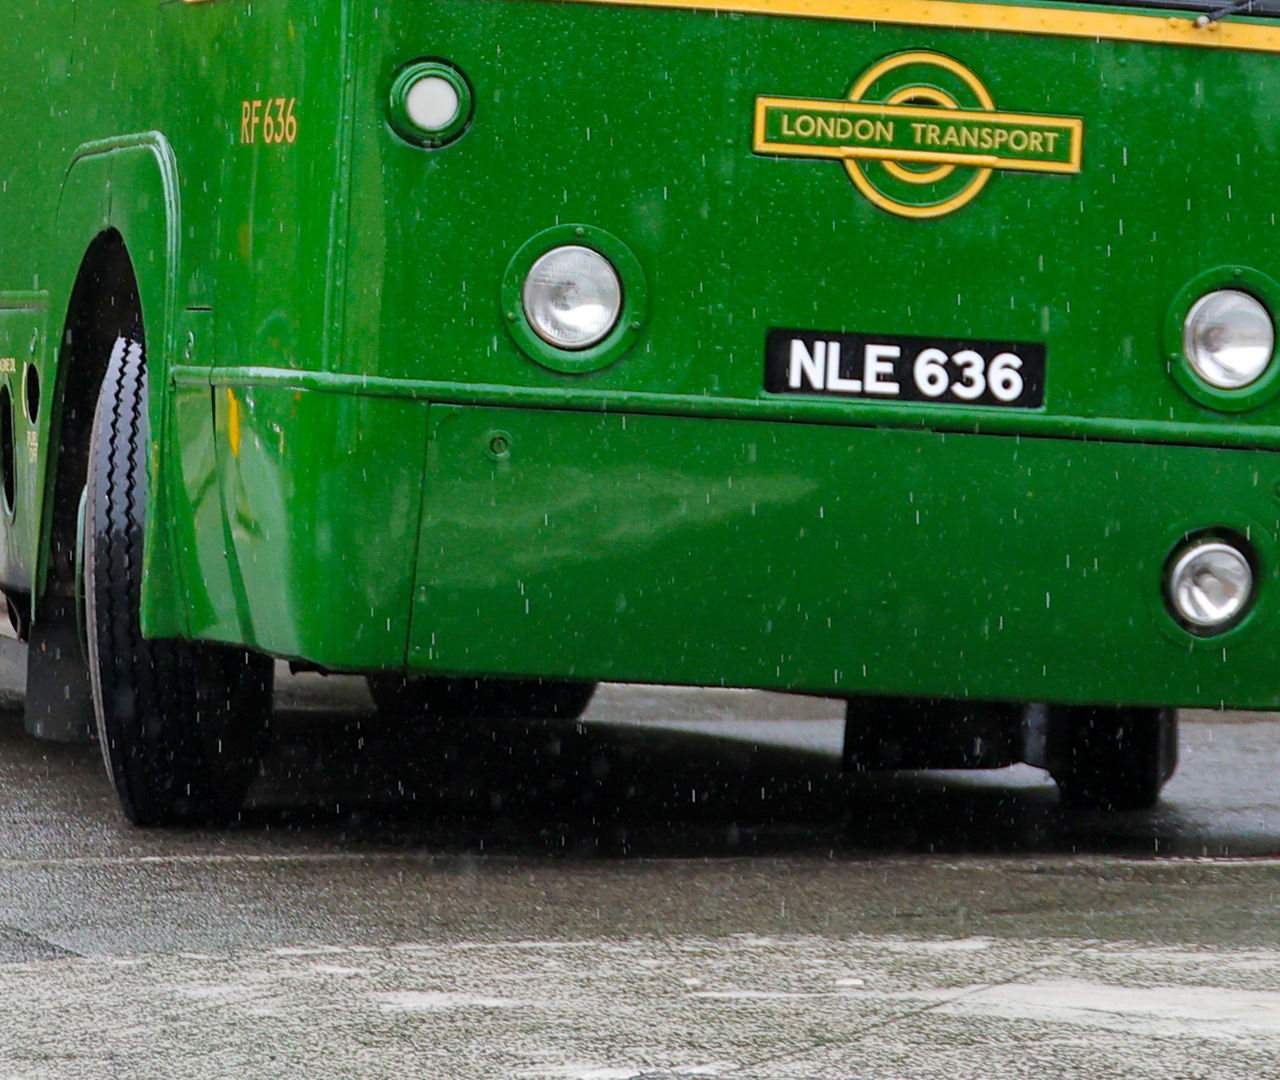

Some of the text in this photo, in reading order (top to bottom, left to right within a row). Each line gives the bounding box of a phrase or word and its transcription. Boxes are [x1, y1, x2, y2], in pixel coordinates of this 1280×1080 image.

[241, 97, 298, 145] RF 636
[780, 113, 1061, 154] LONDON TRANSPORT
[788, 338, 1025, 403] NLE 636
